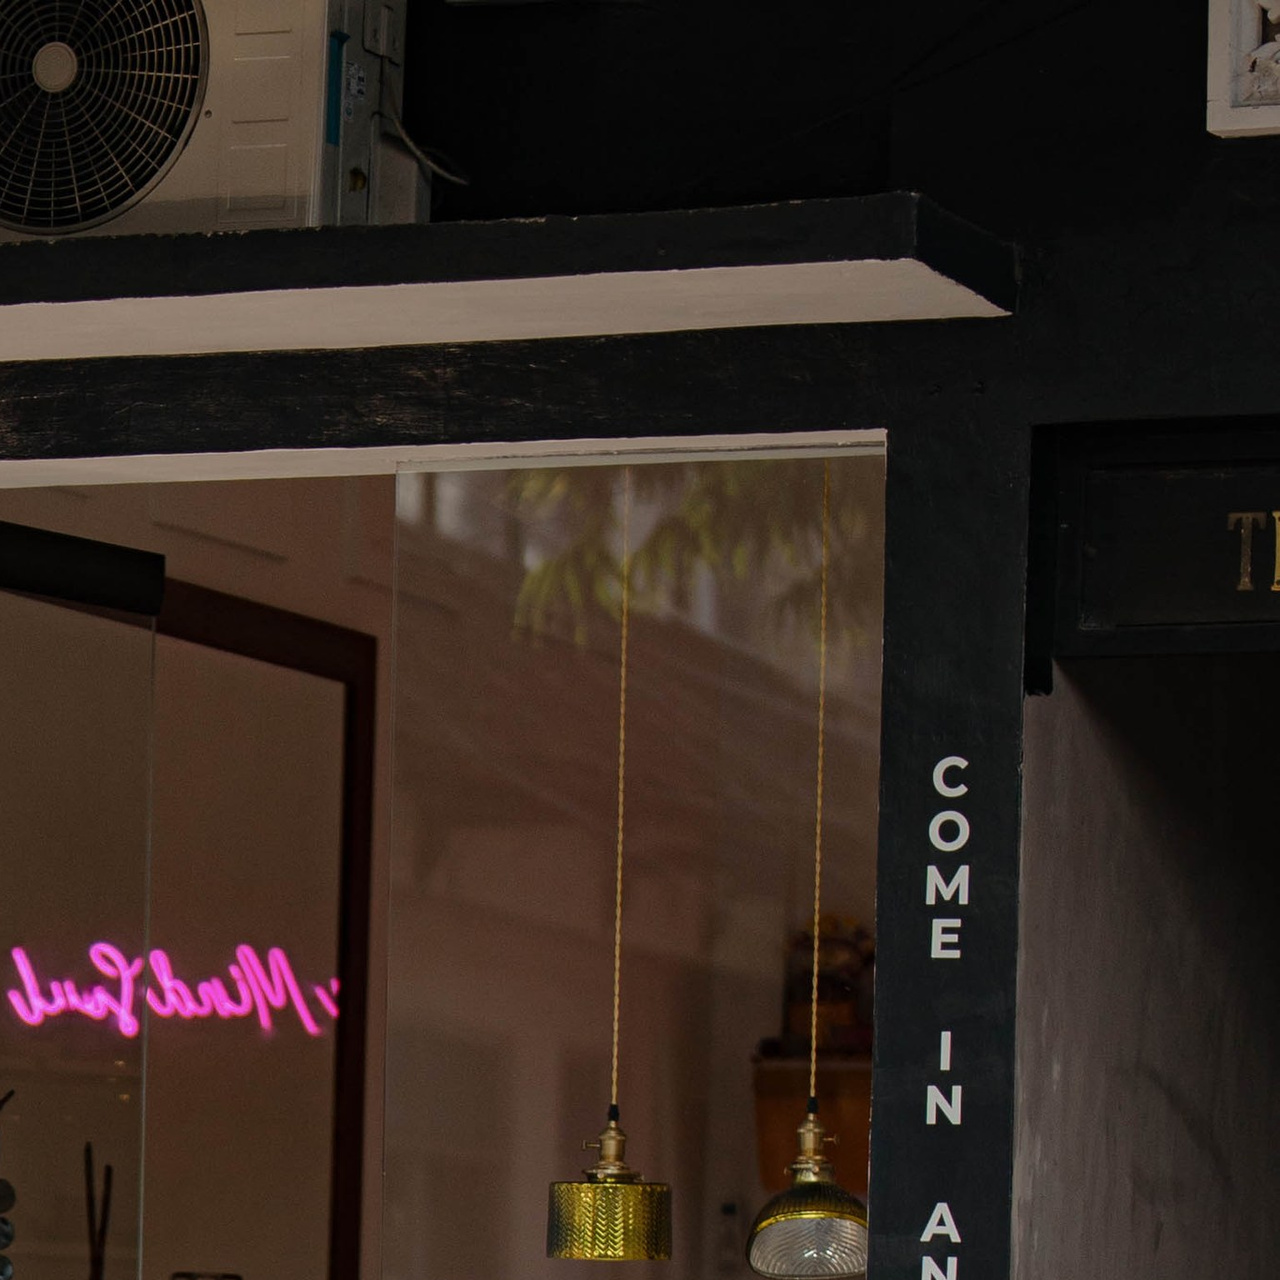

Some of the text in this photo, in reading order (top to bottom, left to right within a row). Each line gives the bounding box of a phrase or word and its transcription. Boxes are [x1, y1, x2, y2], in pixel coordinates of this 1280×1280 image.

[1227, 511, 1280, 592] T
[925, 755, 970, 959] COME
[926, 1030, 962, 1125] IN
